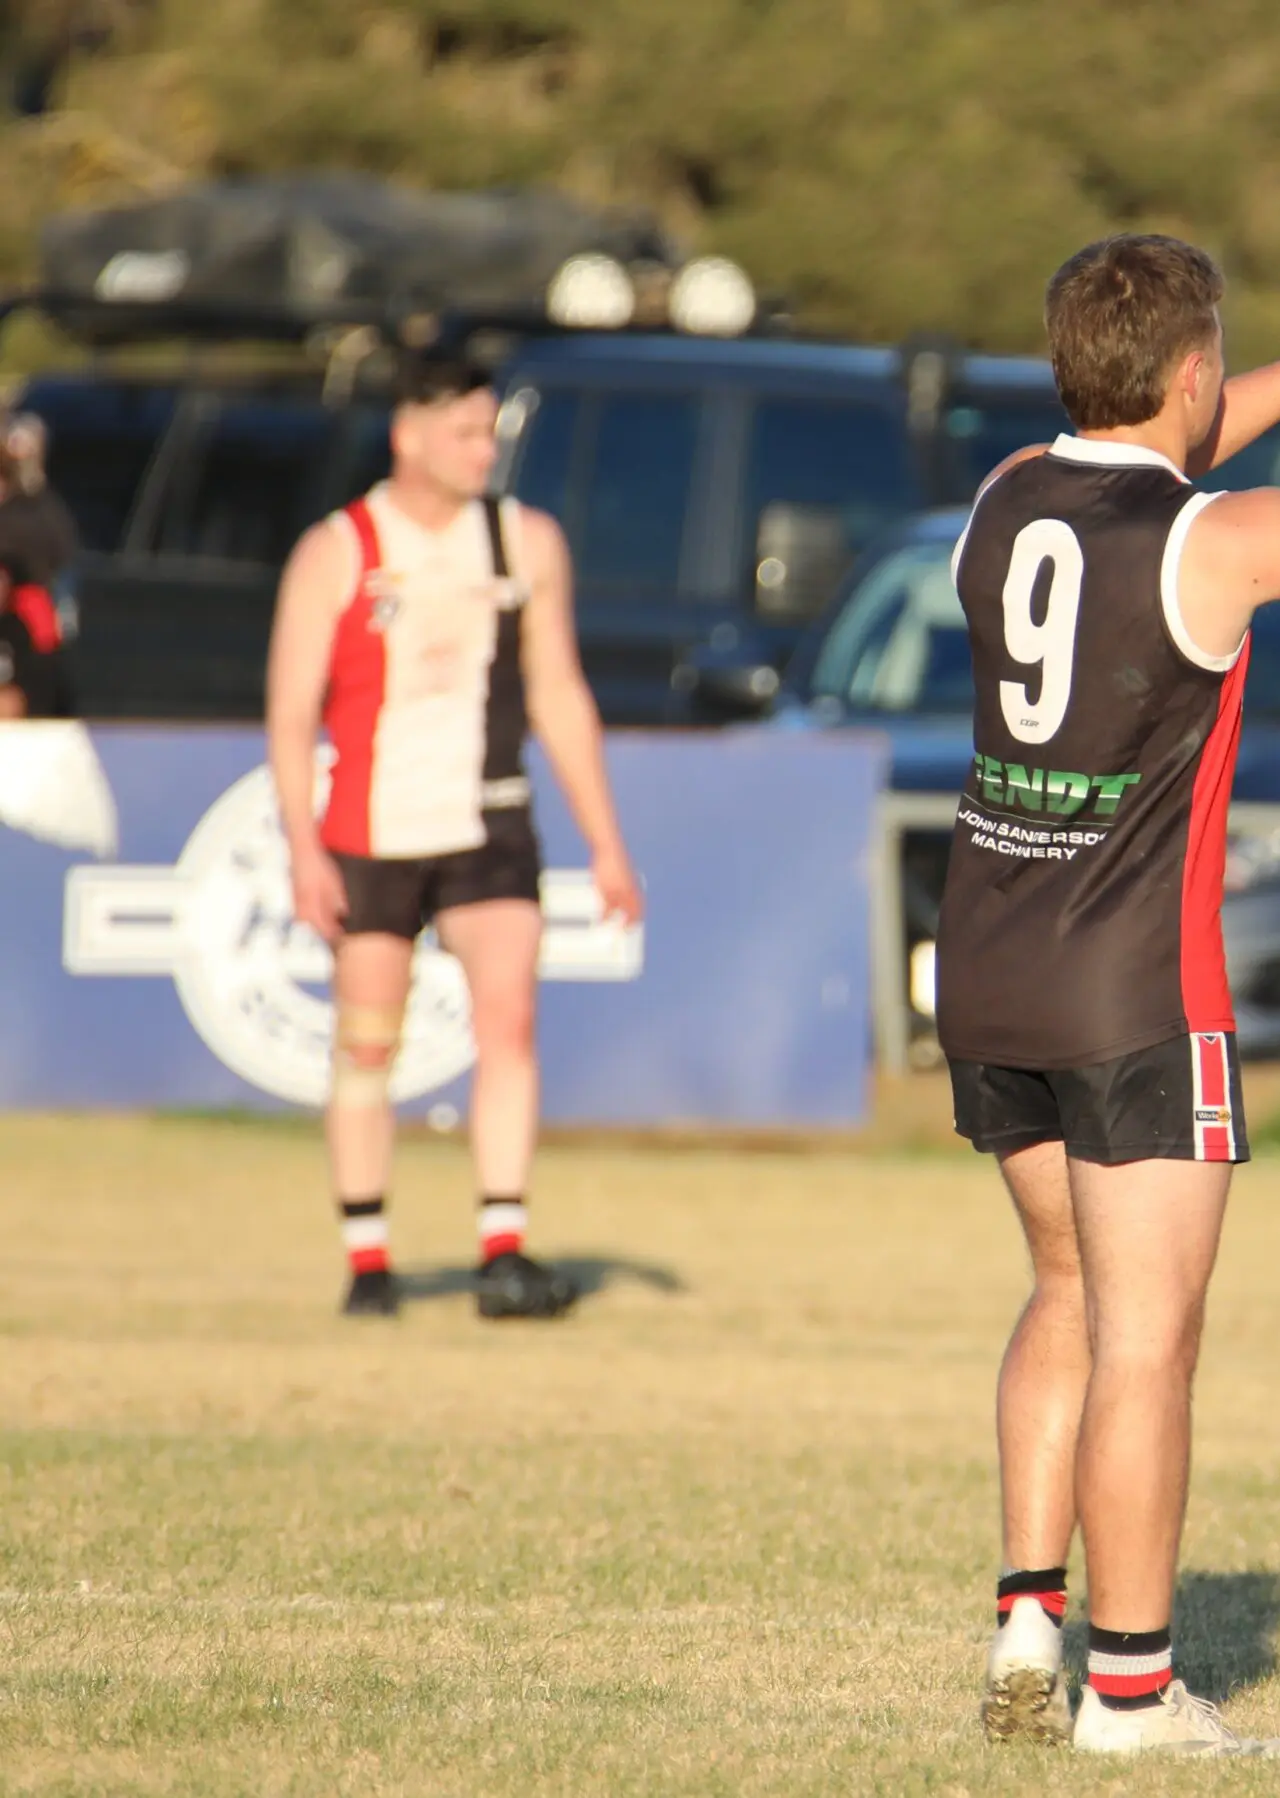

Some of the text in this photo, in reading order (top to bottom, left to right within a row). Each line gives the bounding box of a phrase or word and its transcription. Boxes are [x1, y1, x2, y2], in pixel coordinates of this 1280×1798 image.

[1000, 518, 1084, 744] 9
[957, 809, 1108, 846] JOHN SANERSO
